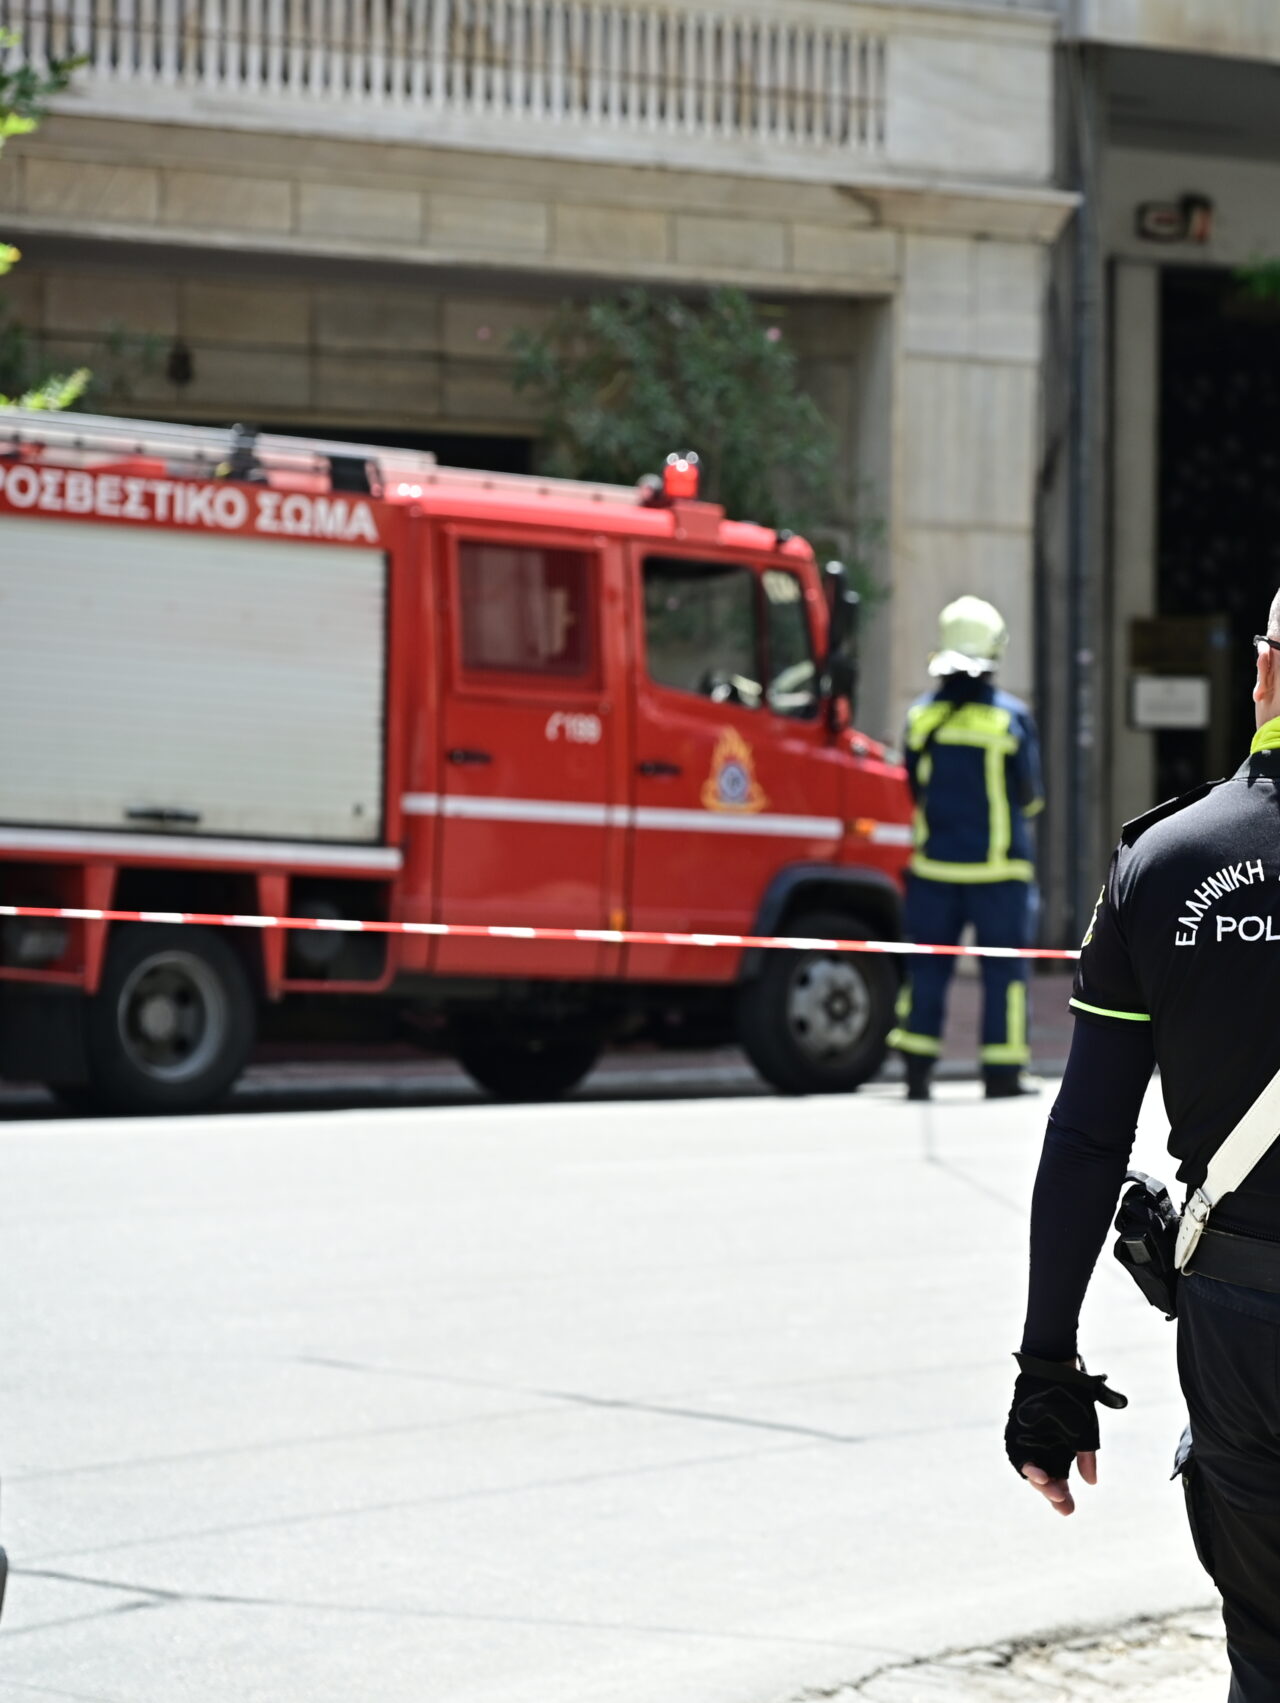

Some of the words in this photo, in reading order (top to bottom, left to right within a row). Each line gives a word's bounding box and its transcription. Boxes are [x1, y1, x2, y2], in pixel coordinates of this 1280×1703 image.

[0, 463, 248, 528] ΟΣΒΕΣΤΙΚΟ
[255, 490, 379, 543] ΣΩΜΑ
[1175, 859, 1265, 946] ΕΛΛΗΝΙΚΗ
